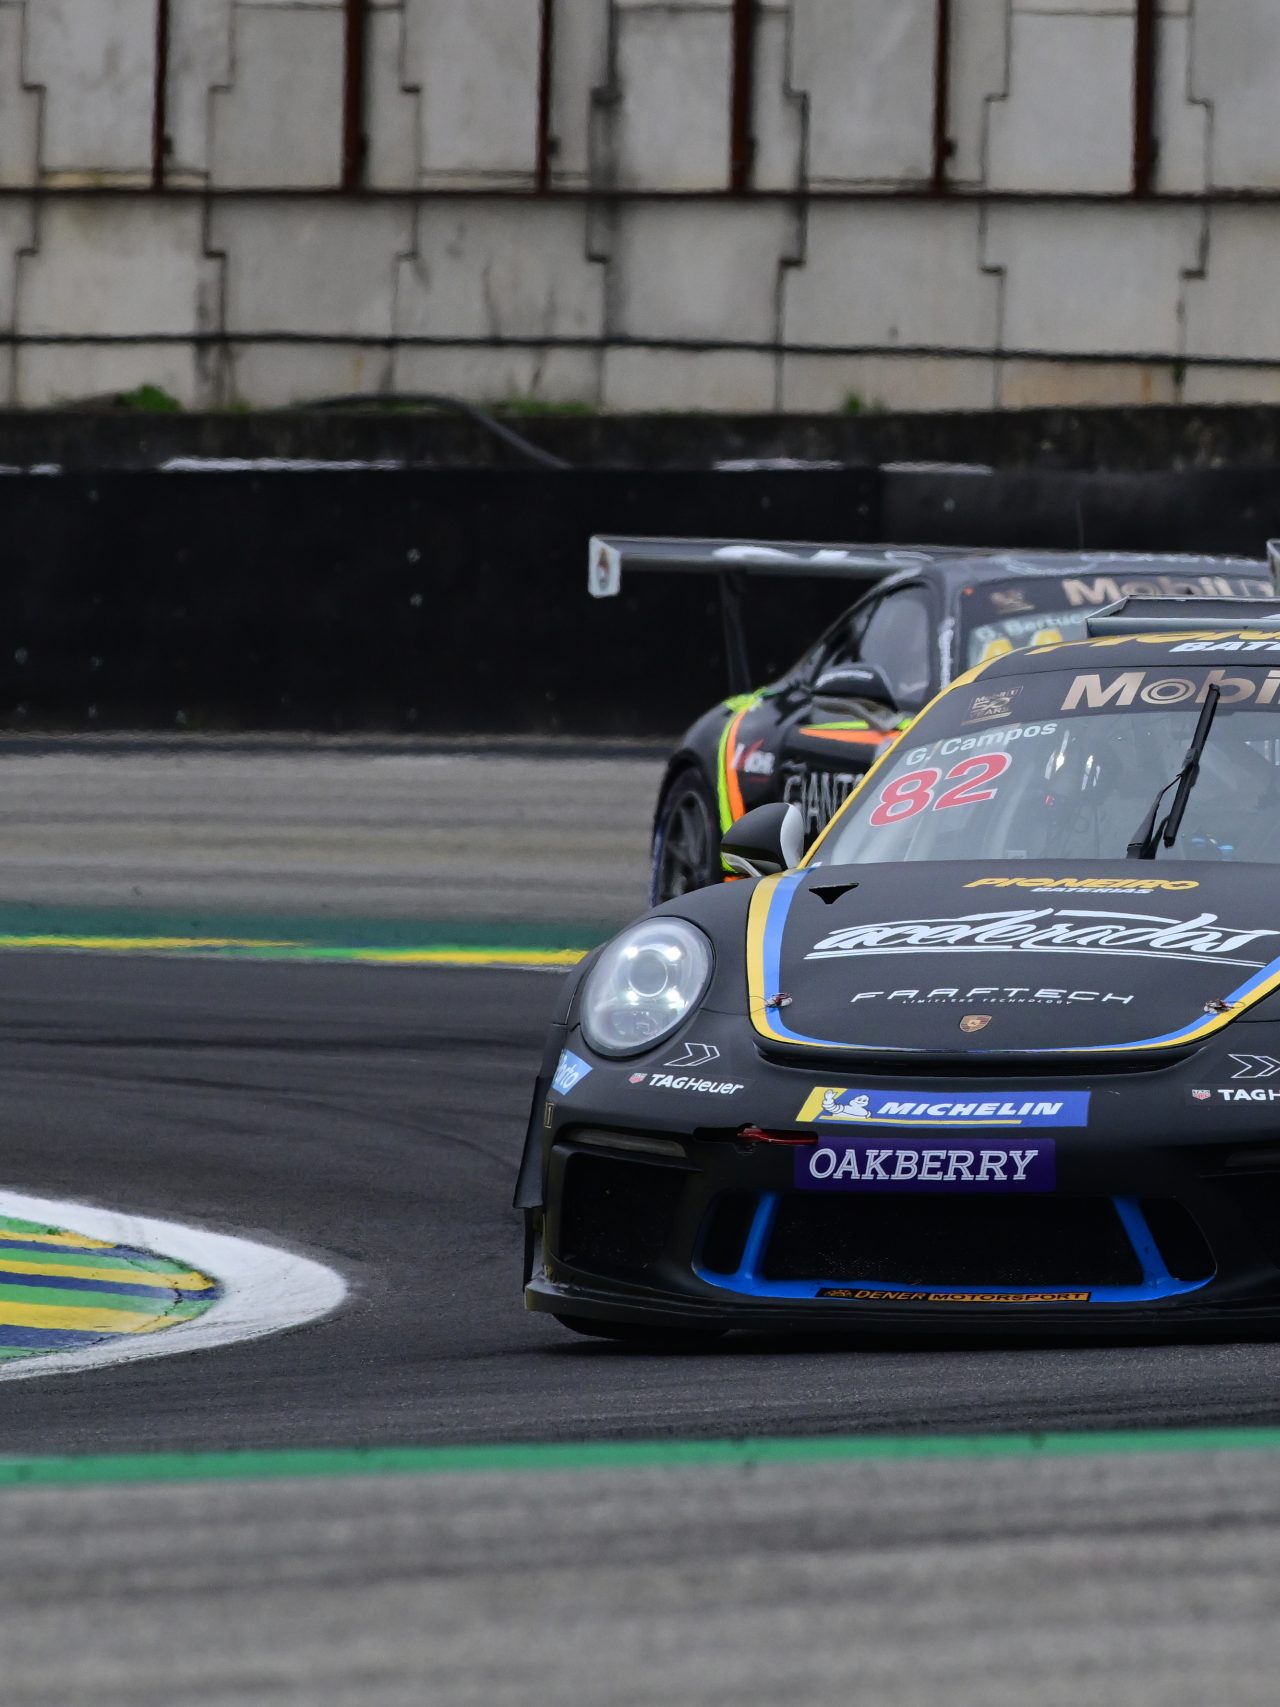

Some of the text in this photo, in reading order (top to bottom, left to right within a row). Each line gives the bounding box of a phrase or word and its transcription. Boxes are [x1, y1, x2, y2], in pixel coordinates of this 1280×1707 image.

[940, 722, 1058, 756] Campos
[869, 751, 1013, 827] 82
[962, 877, 1200, 891] PIONEIRO
[1030, 887, 1155, 895] BATERIAS
[805, 907, 1280, 962] acelerados
[877, 1101, 1064, 1116] MICHELIN
[809, 1147, 1039, 1181] OAKBERRY
[853, 1289, 1088, 1301] DENER MOTORSPORT
